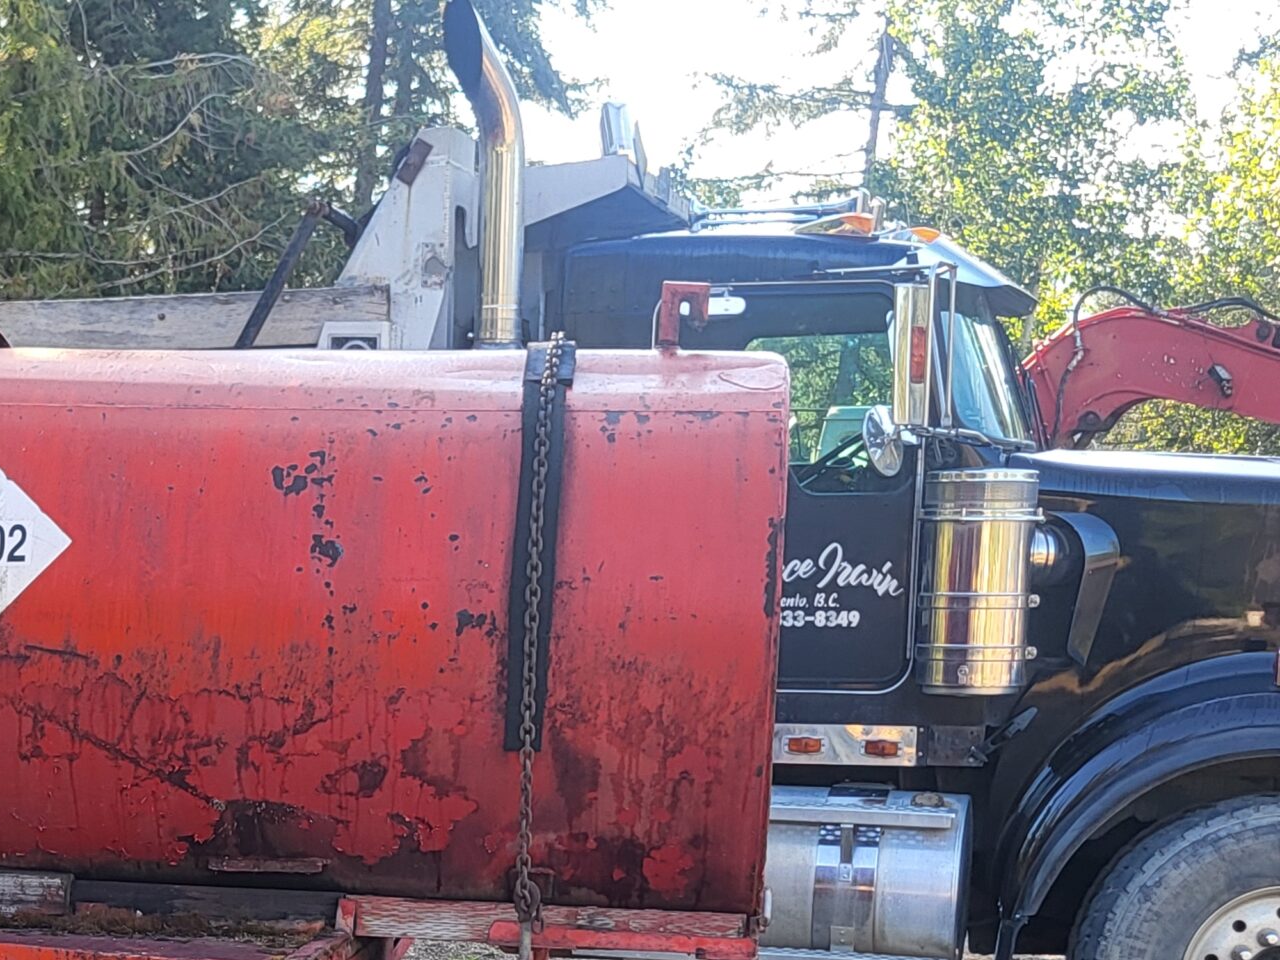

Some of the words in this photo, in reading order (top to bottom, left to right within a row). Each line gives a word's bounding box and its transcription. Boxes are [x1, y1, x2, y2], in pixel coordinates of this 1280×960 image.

[781, 558, 817, 583] ce
[816, 542, 905, 597] Irwin
[780, 592, 809, 608] ento,
[814, 592, 840, 607] B.C.
[780, 610, 861, 627] 33-8349
